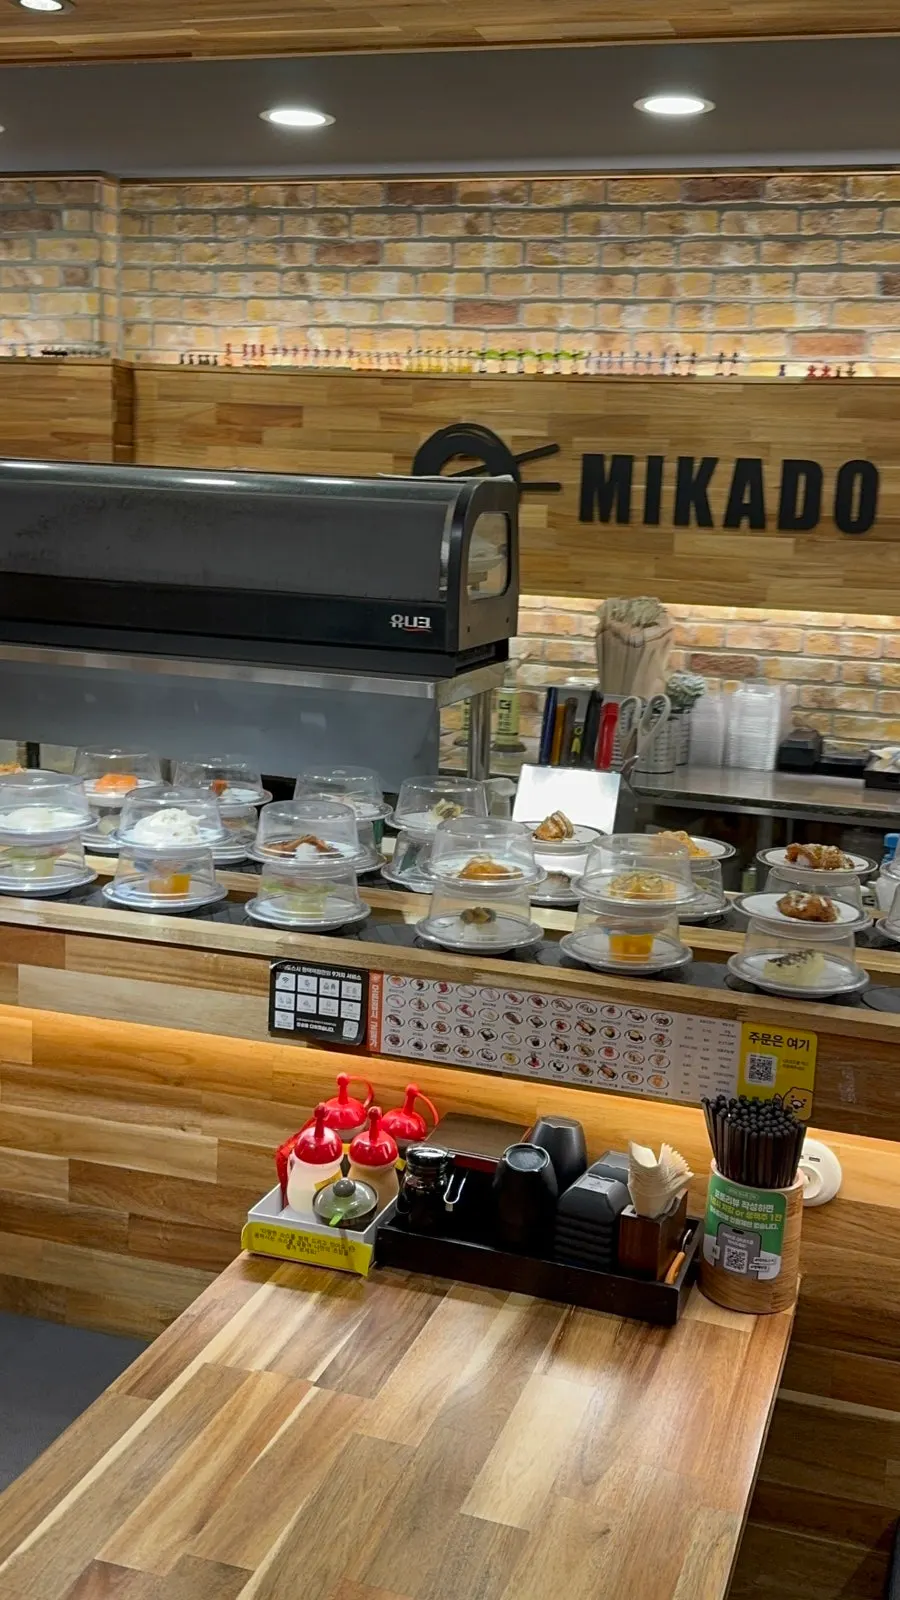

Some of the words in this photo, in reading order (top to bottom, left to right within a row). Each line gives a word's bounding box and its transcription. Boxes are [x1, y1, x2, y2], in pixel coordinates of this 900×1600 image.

[579, 453, 880, 534] MIKADO
[389, 614, 432, 629] 유니크
[749, 1032, 784, 1048] 주문은
[787, 1038, 809, 1051] 여기
[742, 1200, 775, 1212] 작성하면
